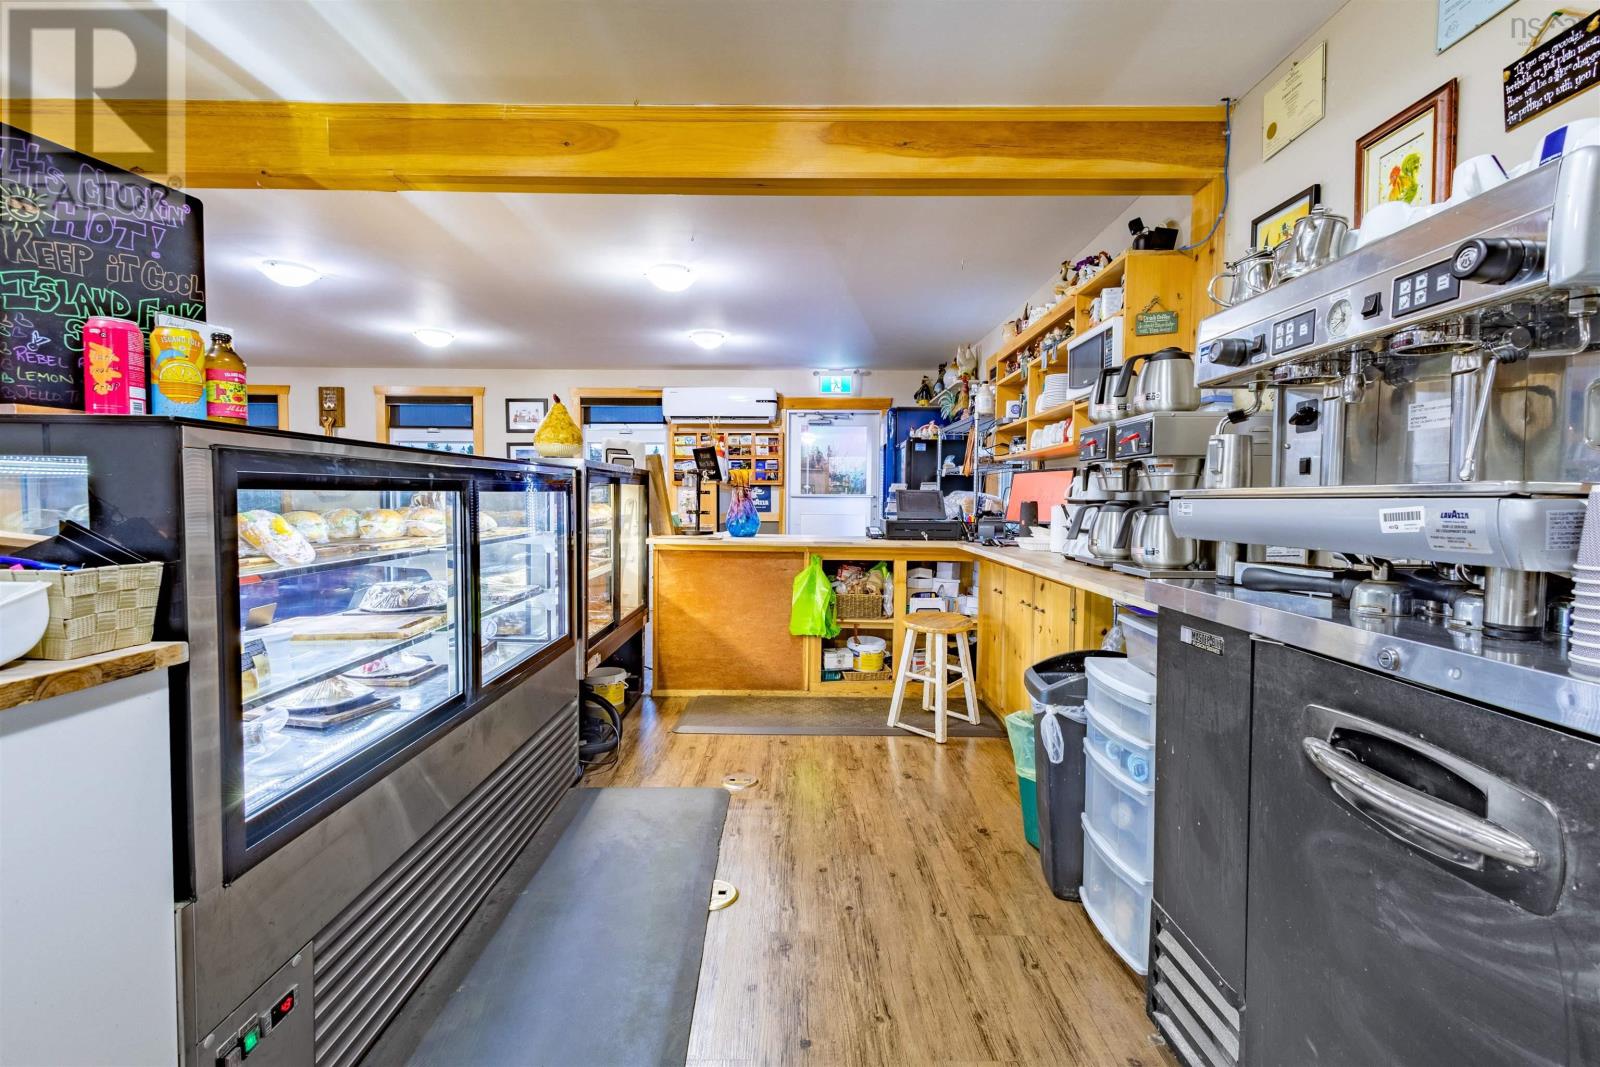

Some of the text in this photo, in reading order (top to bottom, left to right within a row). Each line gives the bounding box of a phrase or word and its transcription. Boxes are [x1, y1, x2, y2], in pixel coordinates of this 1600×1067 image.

[1514, 61, 1525, 77] If
[1538, 50, 1550, 62] are
[1533, 67, 1542, 78] or
[1540, 54, 1556, 77] just
[1557, 49, 1576, 68] plain
[1507, 95, 1523, 108] there
[1524, 81, 1537, 98] will
[1537, 77, 1547, 89] be
[1507, 111, 1519, 124] for
[1518, 97, 1543, 121] putting
[1543, 90, 1554, 104] up
[1555, 78, 1573, 95] with
[2, 226, 94, 277] KEEP
[0, 270, 132, 319] ISLAND
[13, 345, 69, 369] REBEL
[16, 366, 74, 385] LEMON
